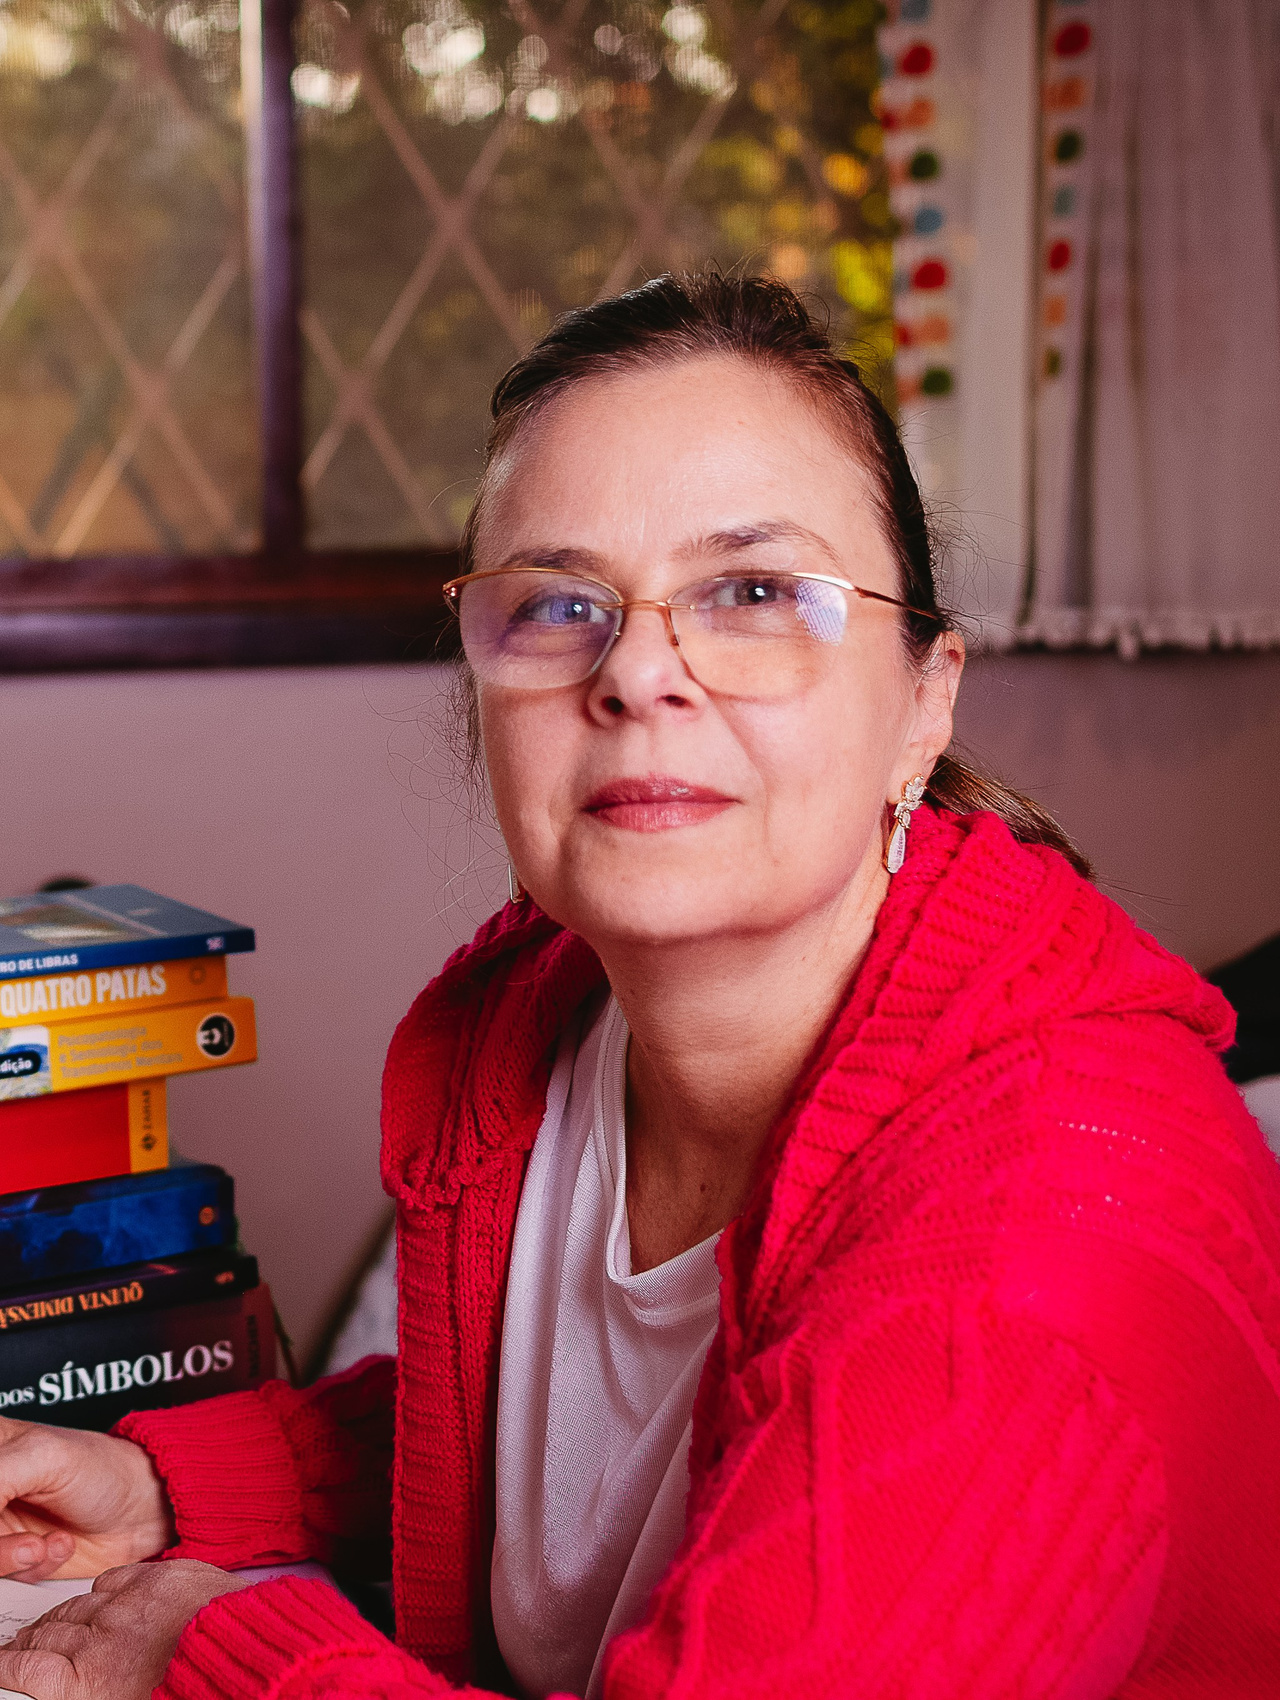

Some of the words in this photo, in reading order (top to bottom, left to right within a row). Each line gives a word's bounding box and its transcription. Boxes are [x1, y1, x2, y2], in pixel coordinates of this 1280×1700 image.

[18, 958, 34, 971] DE
[35, 954, 79, 969] LIBRAS
[0, 974, 92, 1018] QUATRO
[96, 964, 167, 1003] PATAS
[78, 1281, 144, 1310] QUINTA
[38, 1340, 234, 1406] SÍMBOLOS
